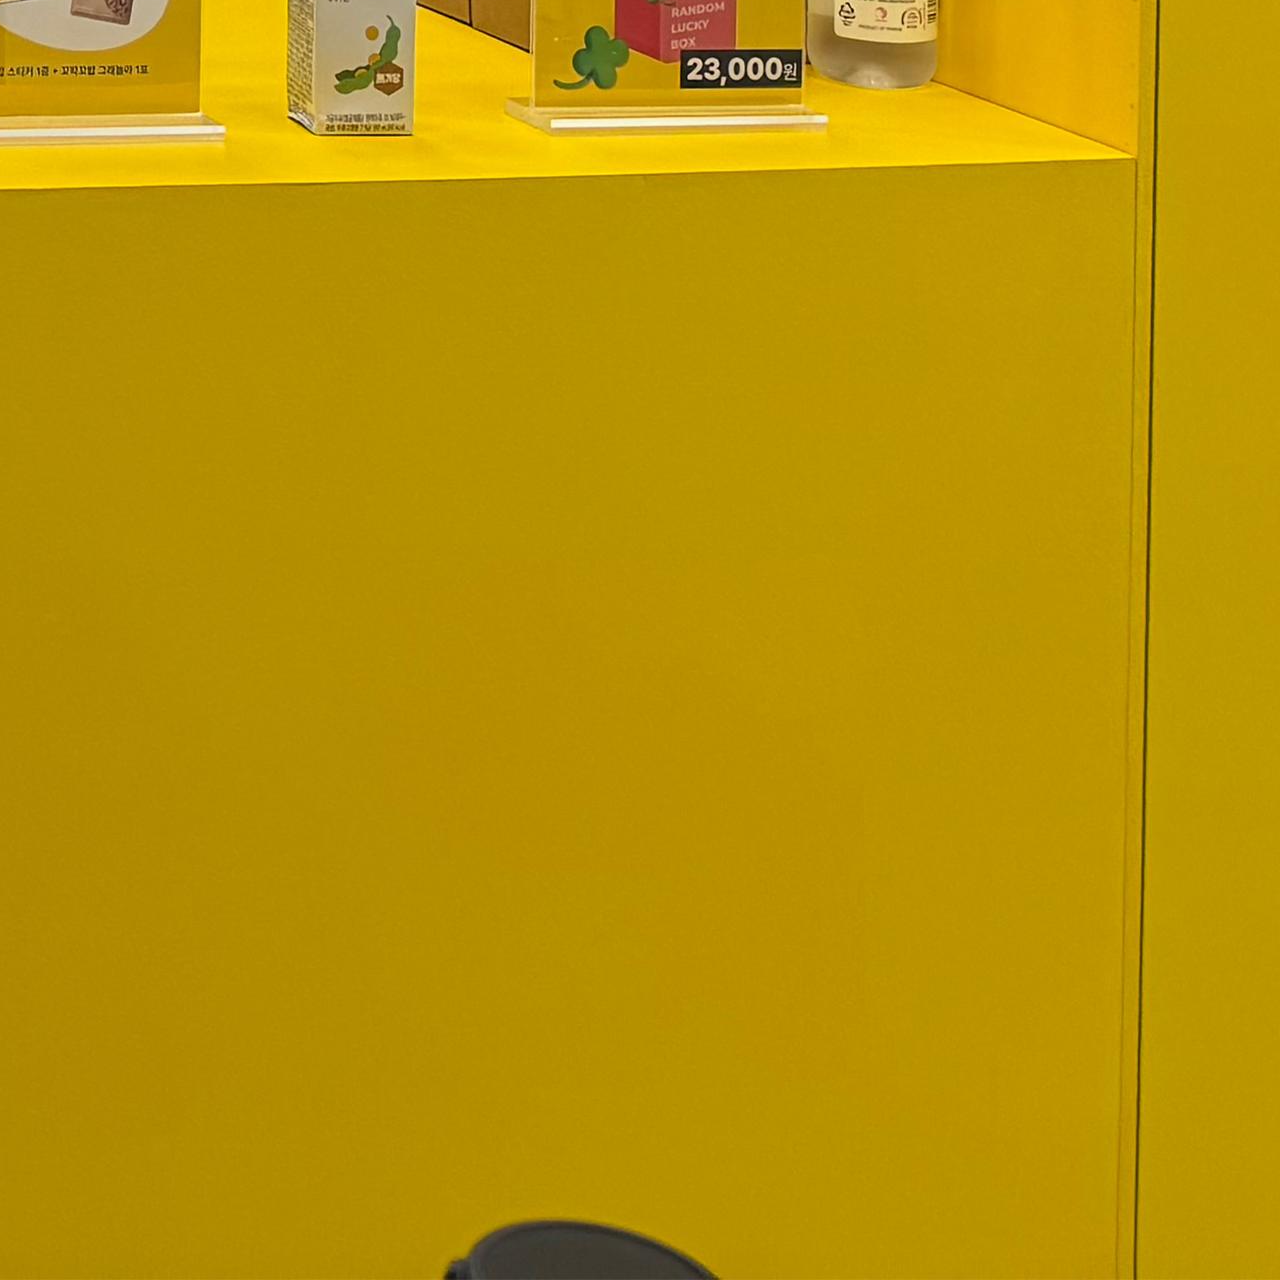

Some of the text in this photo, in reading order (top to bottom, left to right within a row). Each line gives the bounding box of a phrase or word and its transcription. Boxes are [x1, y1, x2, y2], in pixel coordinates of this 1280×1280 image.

[671, 1, 725, 19] RANDOM
[671, 19, 710, 34] LUCKY
[670, 36, 696, 50] BOX
[686, 57, 797, 87] 23,000원
